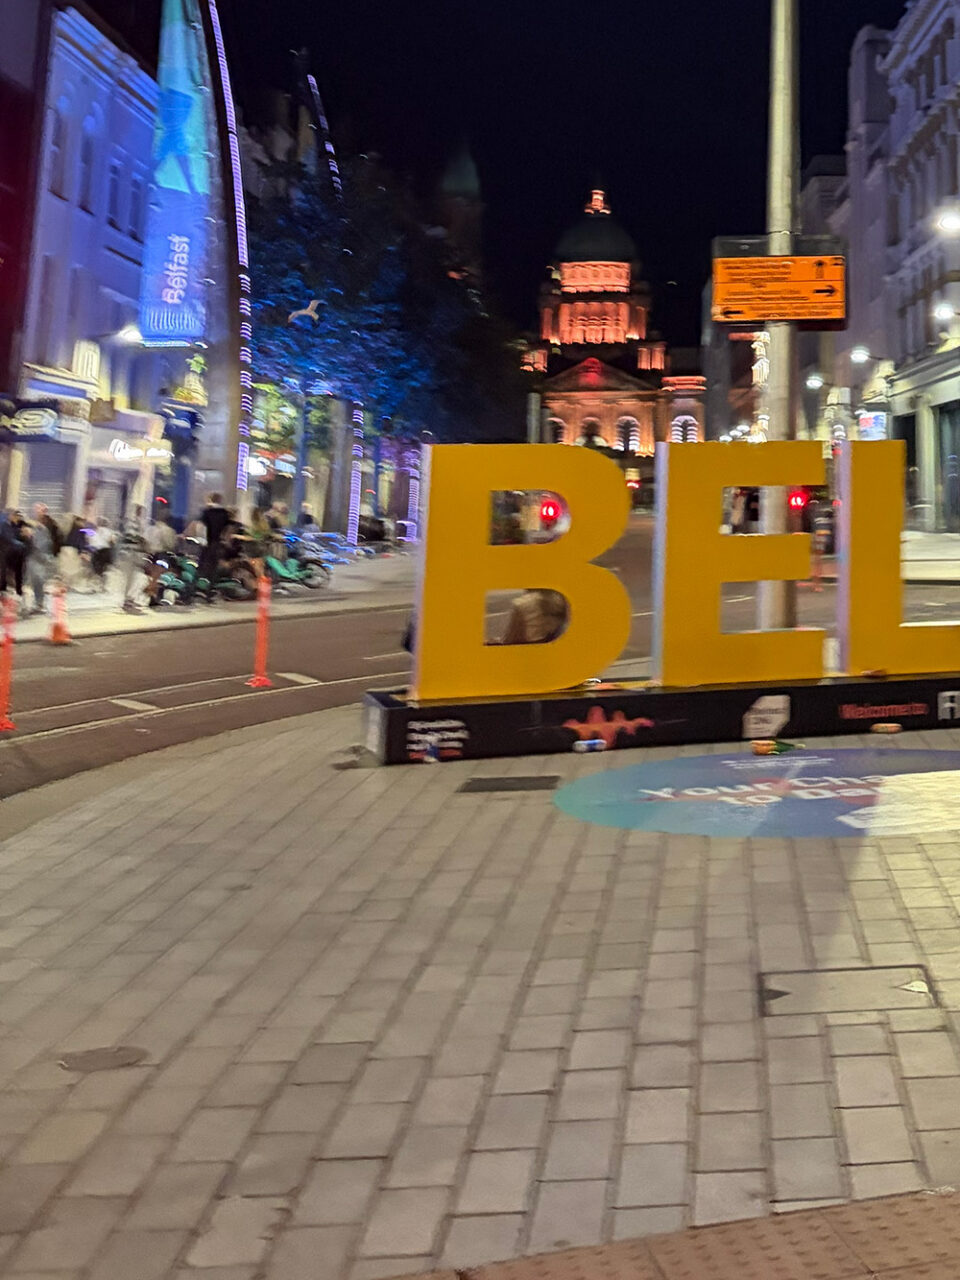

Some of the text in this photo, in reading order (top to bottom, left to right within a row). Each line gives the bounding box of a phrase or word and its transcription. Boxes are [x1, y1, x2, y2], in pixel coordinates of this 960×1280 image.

[162, 233, 191, 305] Belfast
[638, 782, 773, 799] Your
[716, 794, 783, 806] to
